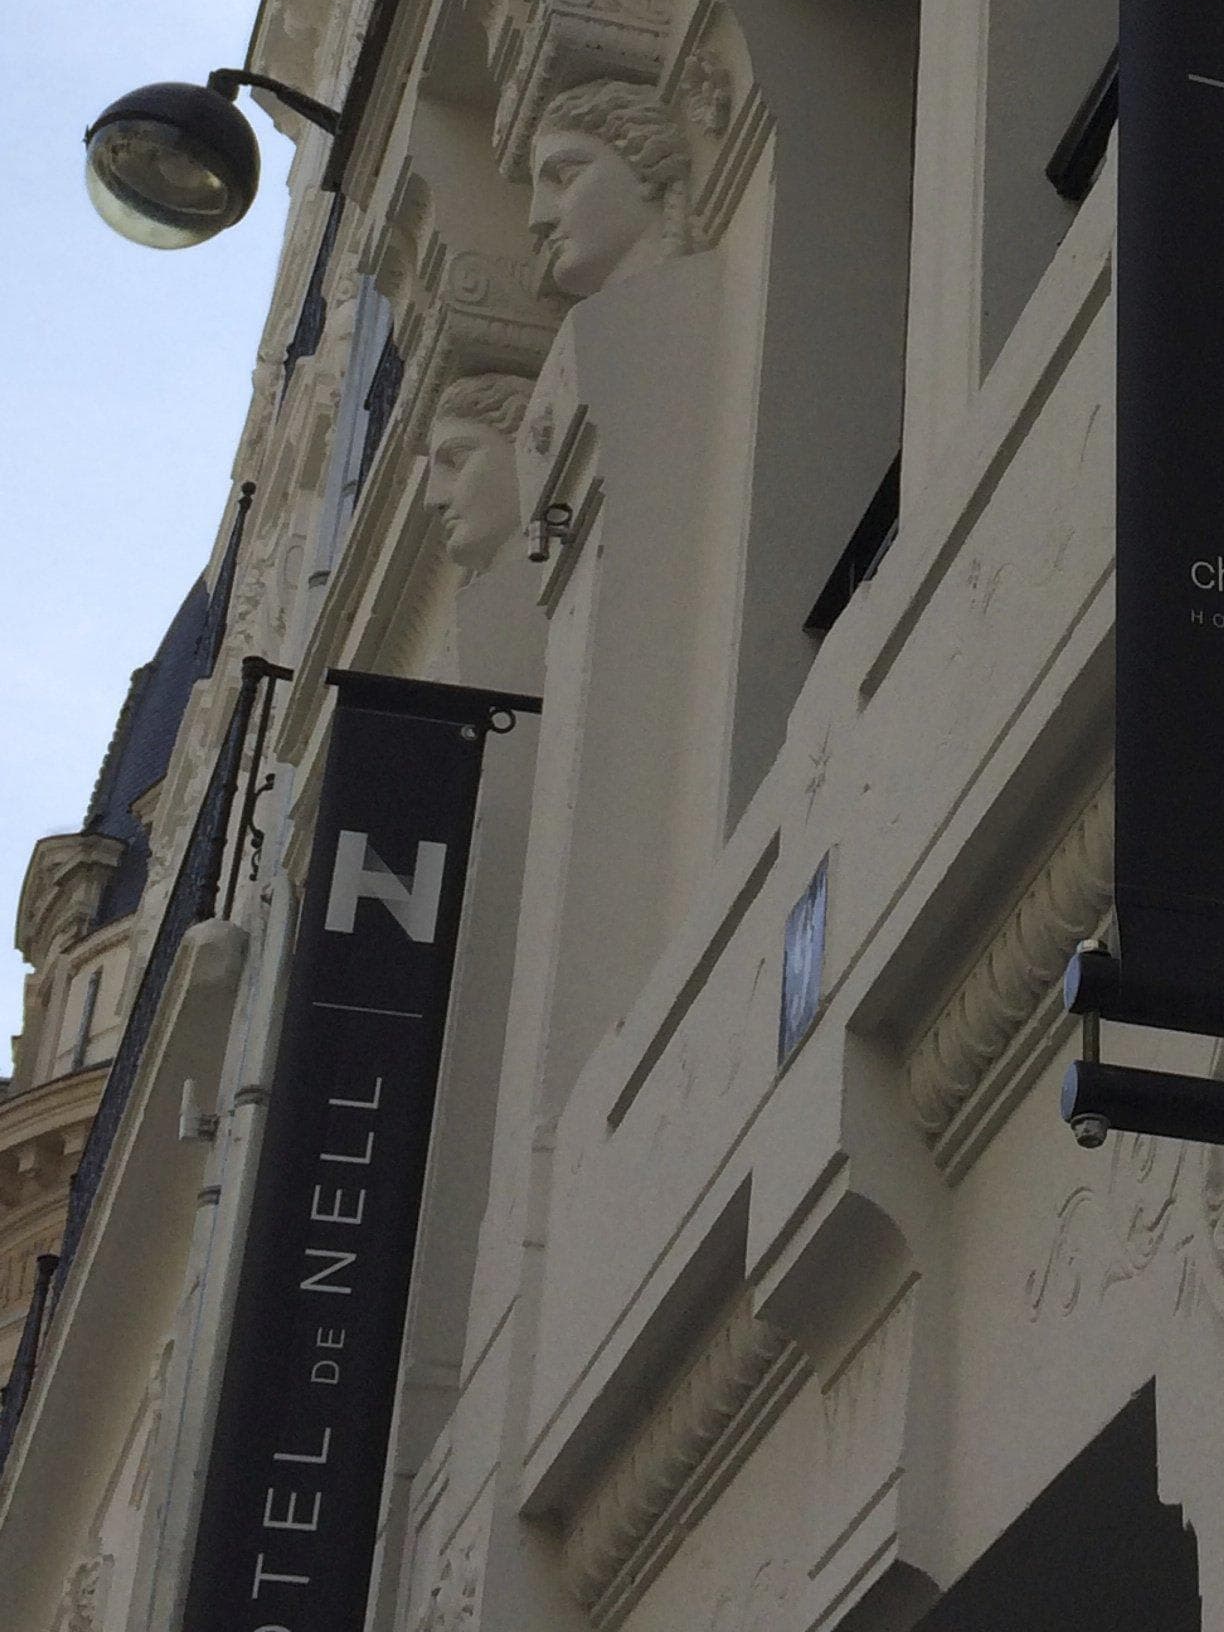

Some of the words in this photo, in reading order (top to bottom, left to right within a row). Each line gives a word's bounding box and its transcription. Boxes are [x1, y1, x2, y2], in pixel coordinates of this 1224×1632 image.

[323, 830, 447, 943] N
[300, 1076, 382, 1294] NELL
[311, 1326, 345, 1384] DE
[252, 1427, 331, 1632] TEL
